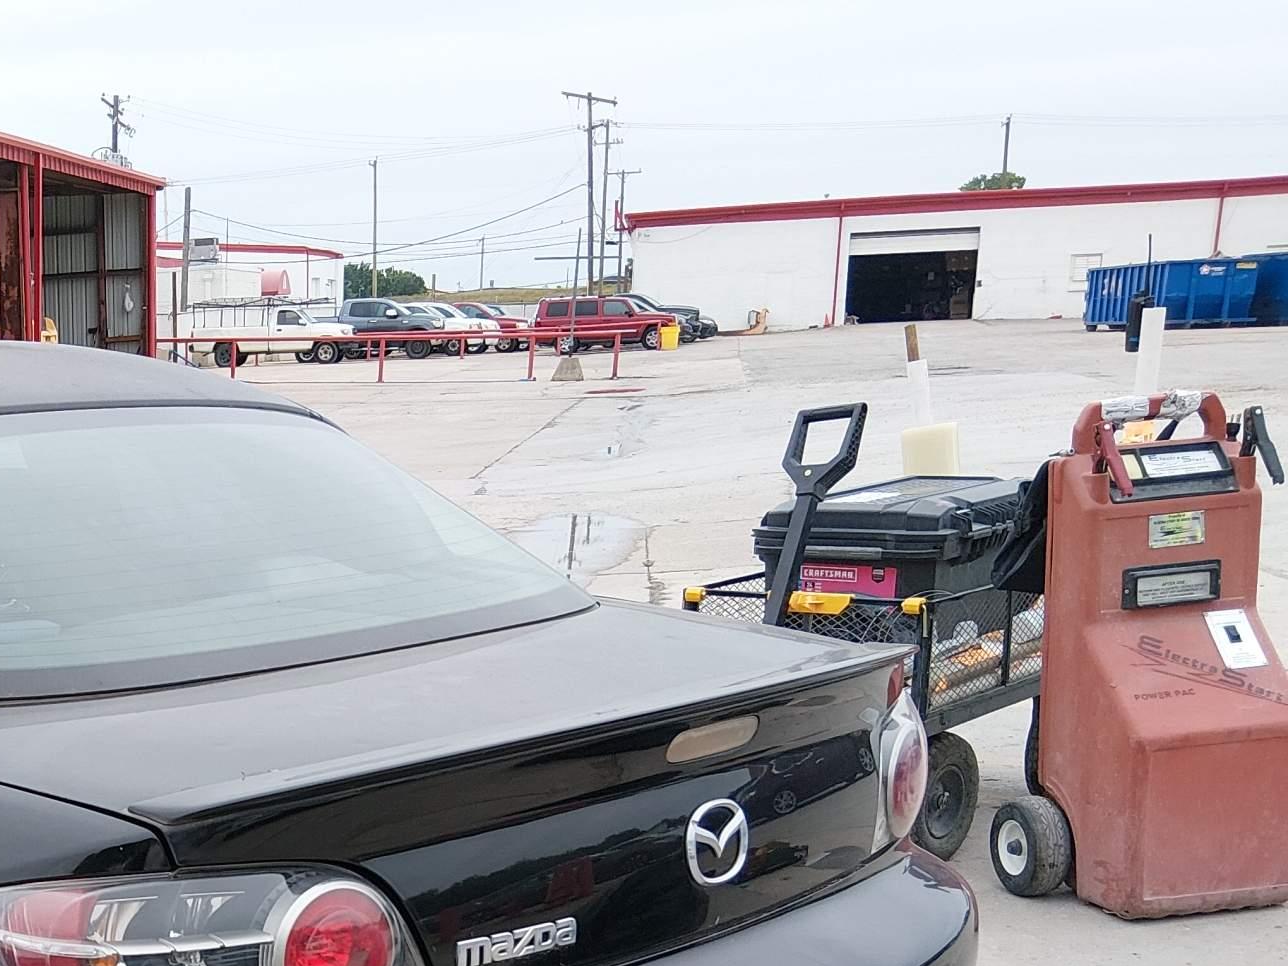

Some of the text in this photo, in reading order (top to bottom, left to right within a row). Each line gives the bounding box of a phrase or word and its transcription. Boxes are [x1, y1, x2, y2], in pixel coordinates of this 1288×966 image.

[803, 568, 855, 580] CRAFTSMAN
[1137, 634, 1284, 702] Electra Start
[1133, 687, 1197, 701] POWER PAC
